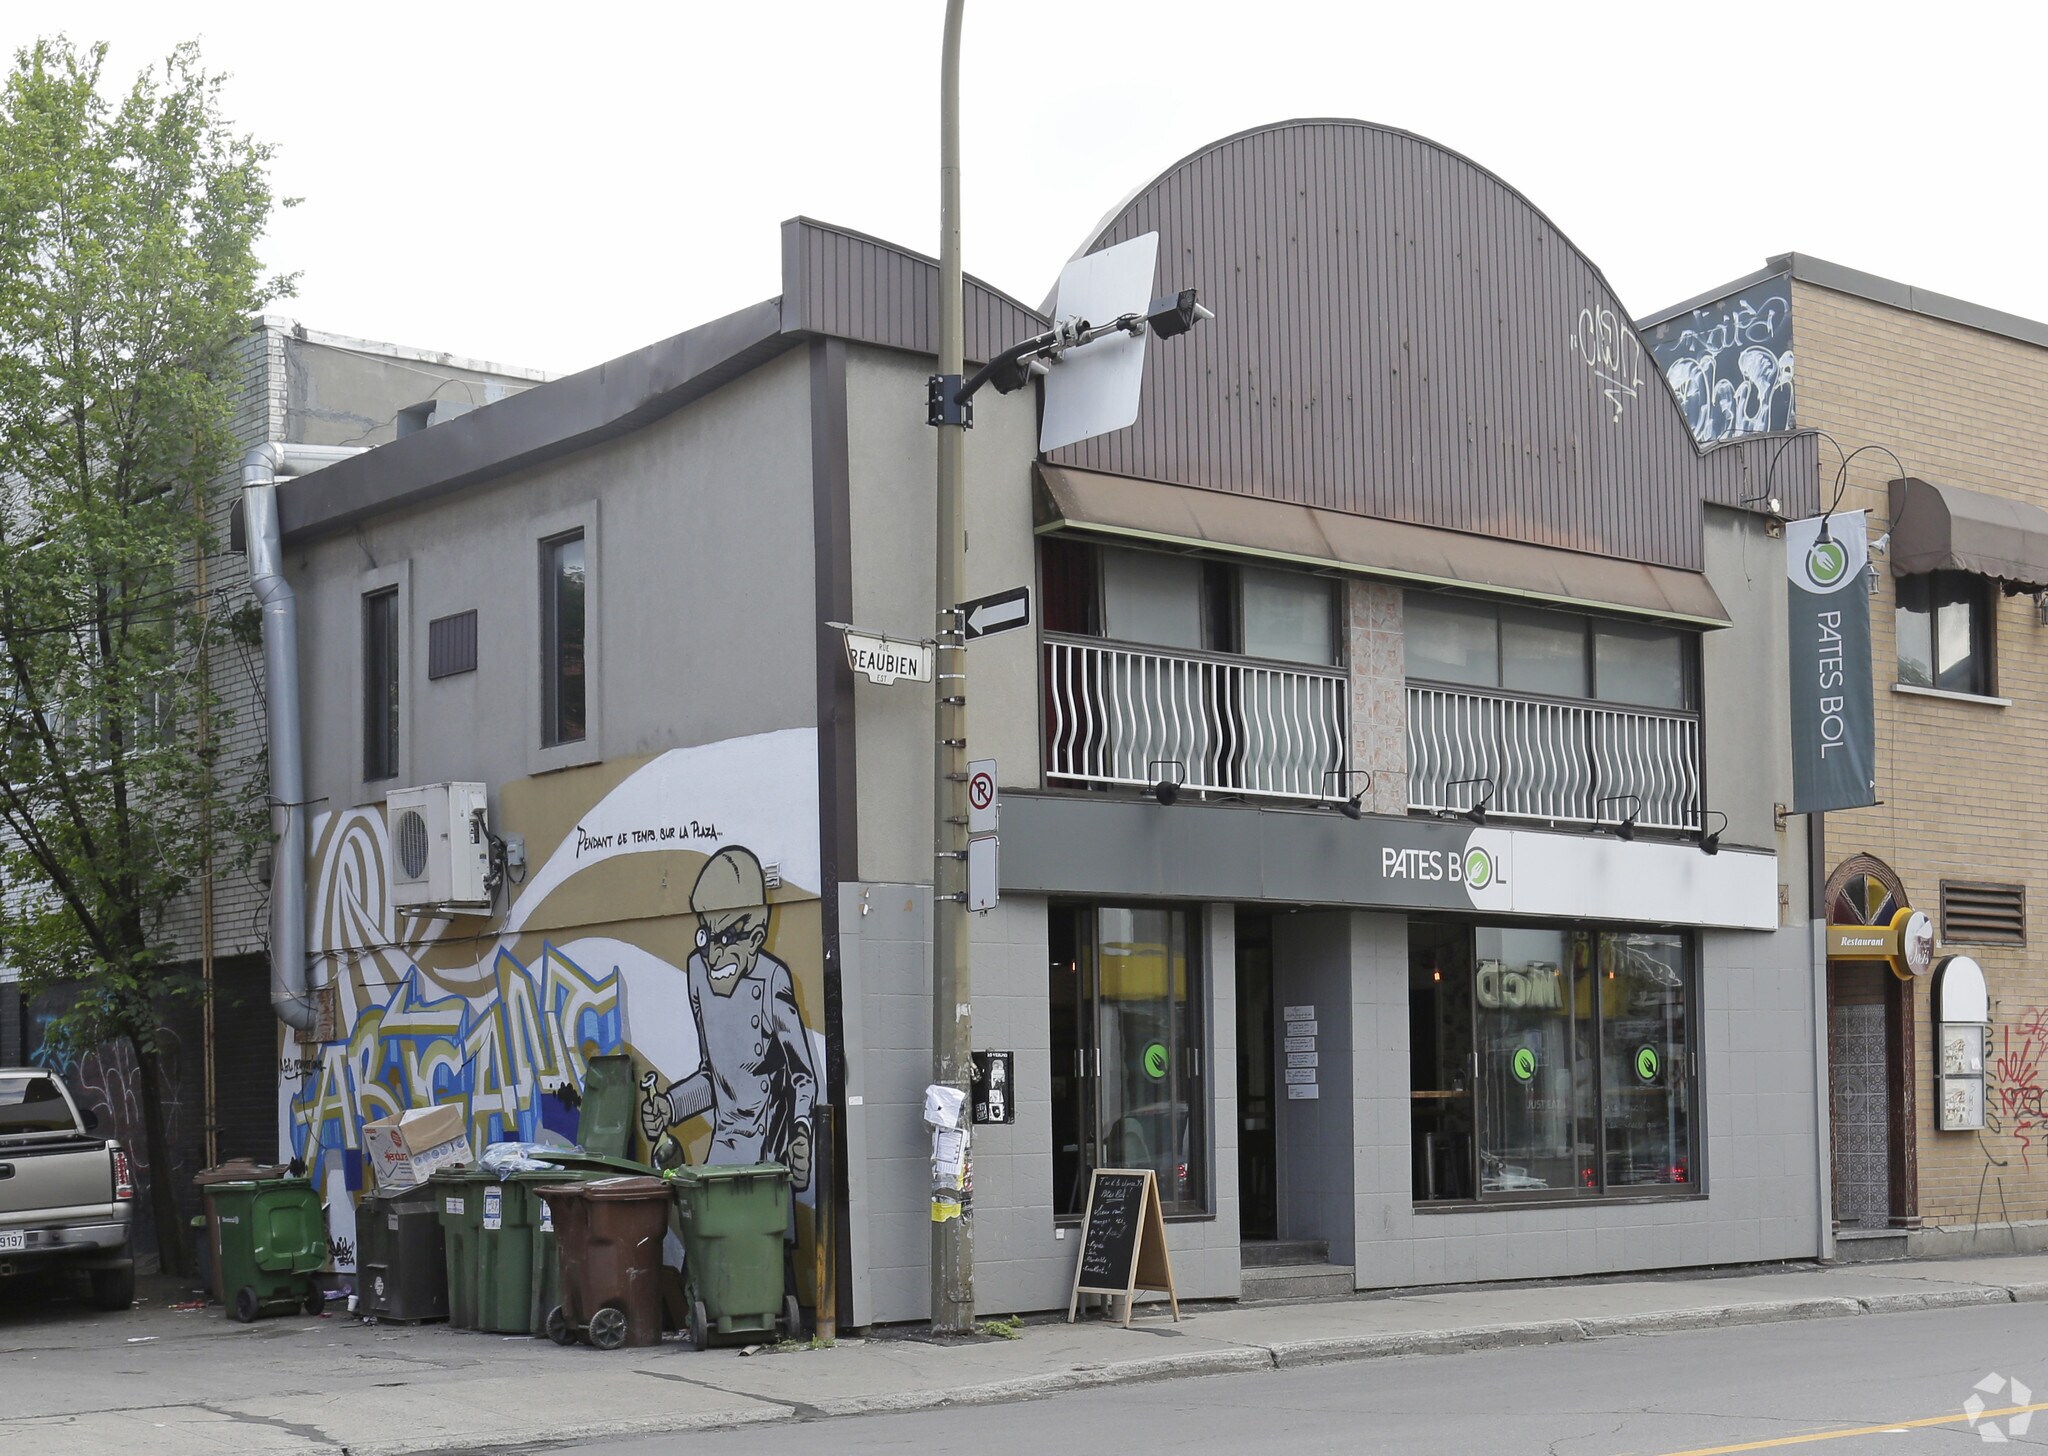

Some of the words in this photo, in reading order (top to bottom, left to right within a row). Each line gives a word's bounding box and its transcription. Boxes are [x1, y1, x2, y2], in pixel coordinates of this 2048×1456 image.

[850, 648, 917, 676] BEAUBIEN
[1817, 610, 1843, 689] PATES
[877, 674, 887, 682] EST
[1819, 696, 1844, 759] BOL
[1382, 847, 1443, 881] PATES
[1448, 846, 1507, 890] BOL
[1841, 936, 1884, 946] Restaurant
